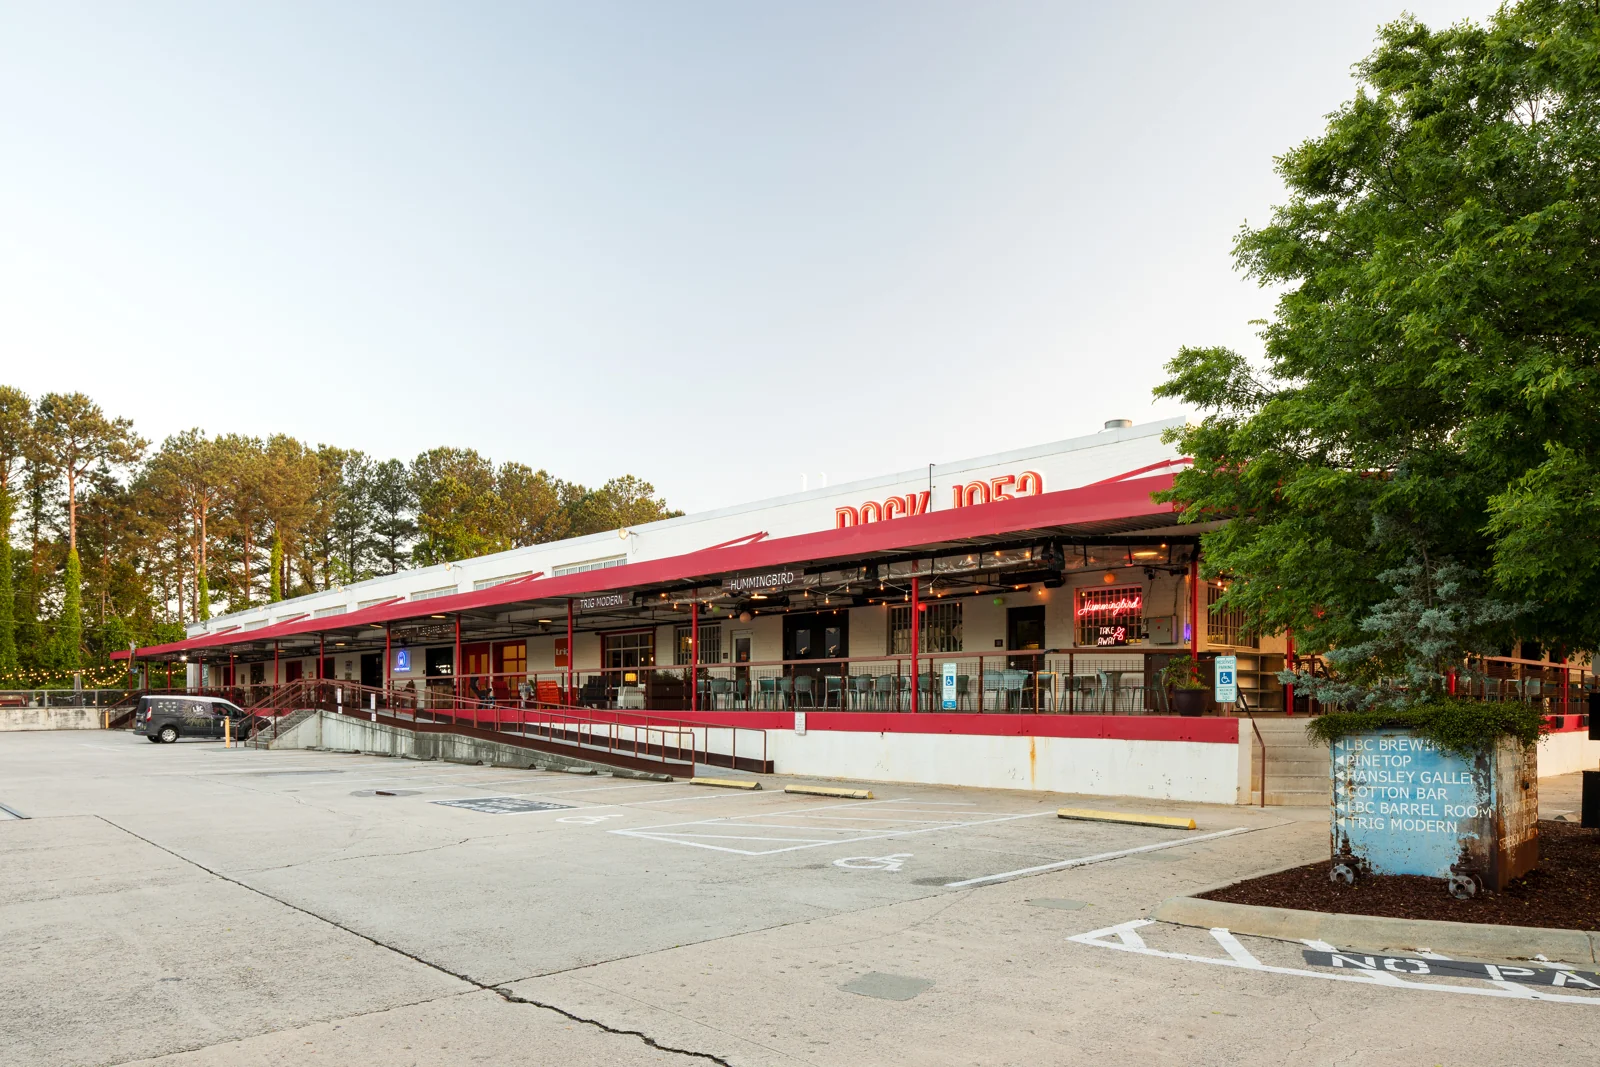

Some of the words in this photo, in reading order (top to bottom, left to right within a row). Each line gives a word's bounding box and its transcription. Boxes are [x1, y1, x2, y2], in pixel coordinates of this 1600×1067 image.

[730, 572, 794, 591] HUMMINGBIRD
[580, 598, 595, 609] TRIG
[596, 594, 623, 607] MODERN
[1077, 596, 1140, 616] Hummingbird
[1099, 626, 1115, 635] TAKE
[1097, 636, 1116, 646] AWAY
[192, 704, 204, 713] LBC
[1346, 739, 1374, 751] LBC
[1379, 739, 1450, 751] BREWIN
[1346, 754, 1412, 767] PINETOP
[1347, 770, 1416, 783] HANSLEY
[1420, 771, 1473, 785] GALLE
[1347, 786, 1410, 799] COTTON
[1416, 787, 1449, 801] BAR
[1347, 801, 1375, 814] LBC
[1380, 802, 1439, 817] BARREL
[1444, 804, 1492, 819] ROOM
[1348, 816, 1385, 830] TRIG
[1390, 818, 1458, 833] MODERN
[1331, 953, 1431, 975] NO
